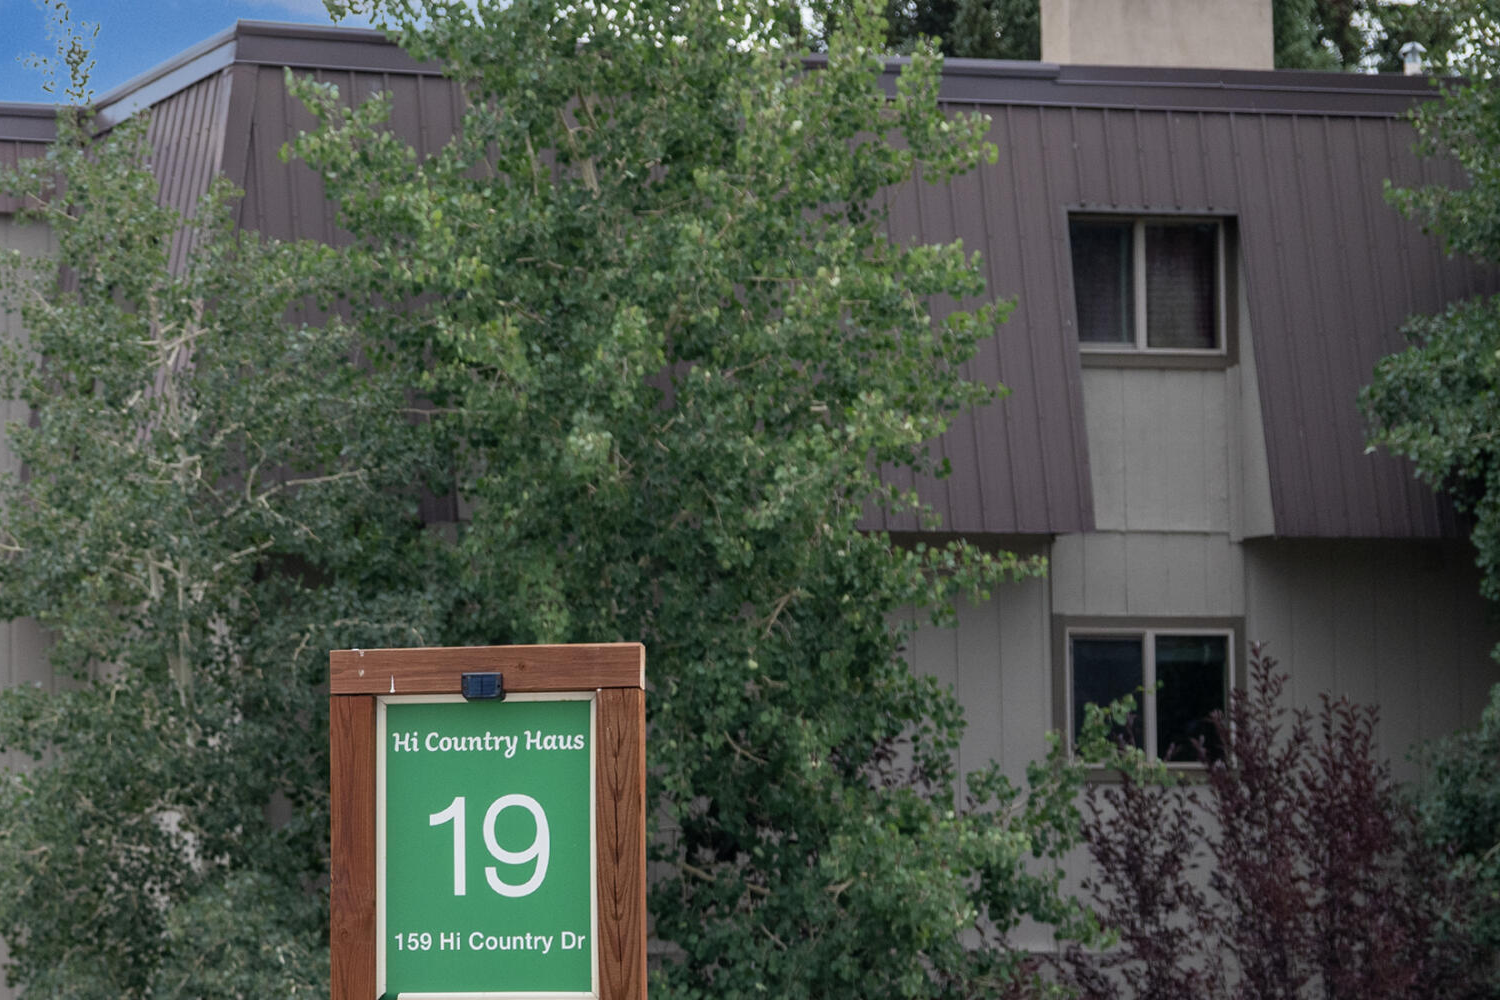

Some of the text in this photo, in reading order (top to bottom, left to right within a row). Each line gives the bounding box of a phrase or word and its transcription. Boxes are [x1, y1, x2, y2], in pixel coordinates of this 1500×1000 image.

[392, 730, 585, 758] Hi Country Haus
[429, 794, 550, 898] 19
[394, 931, 586, 954] 159 Hi Country Dr
